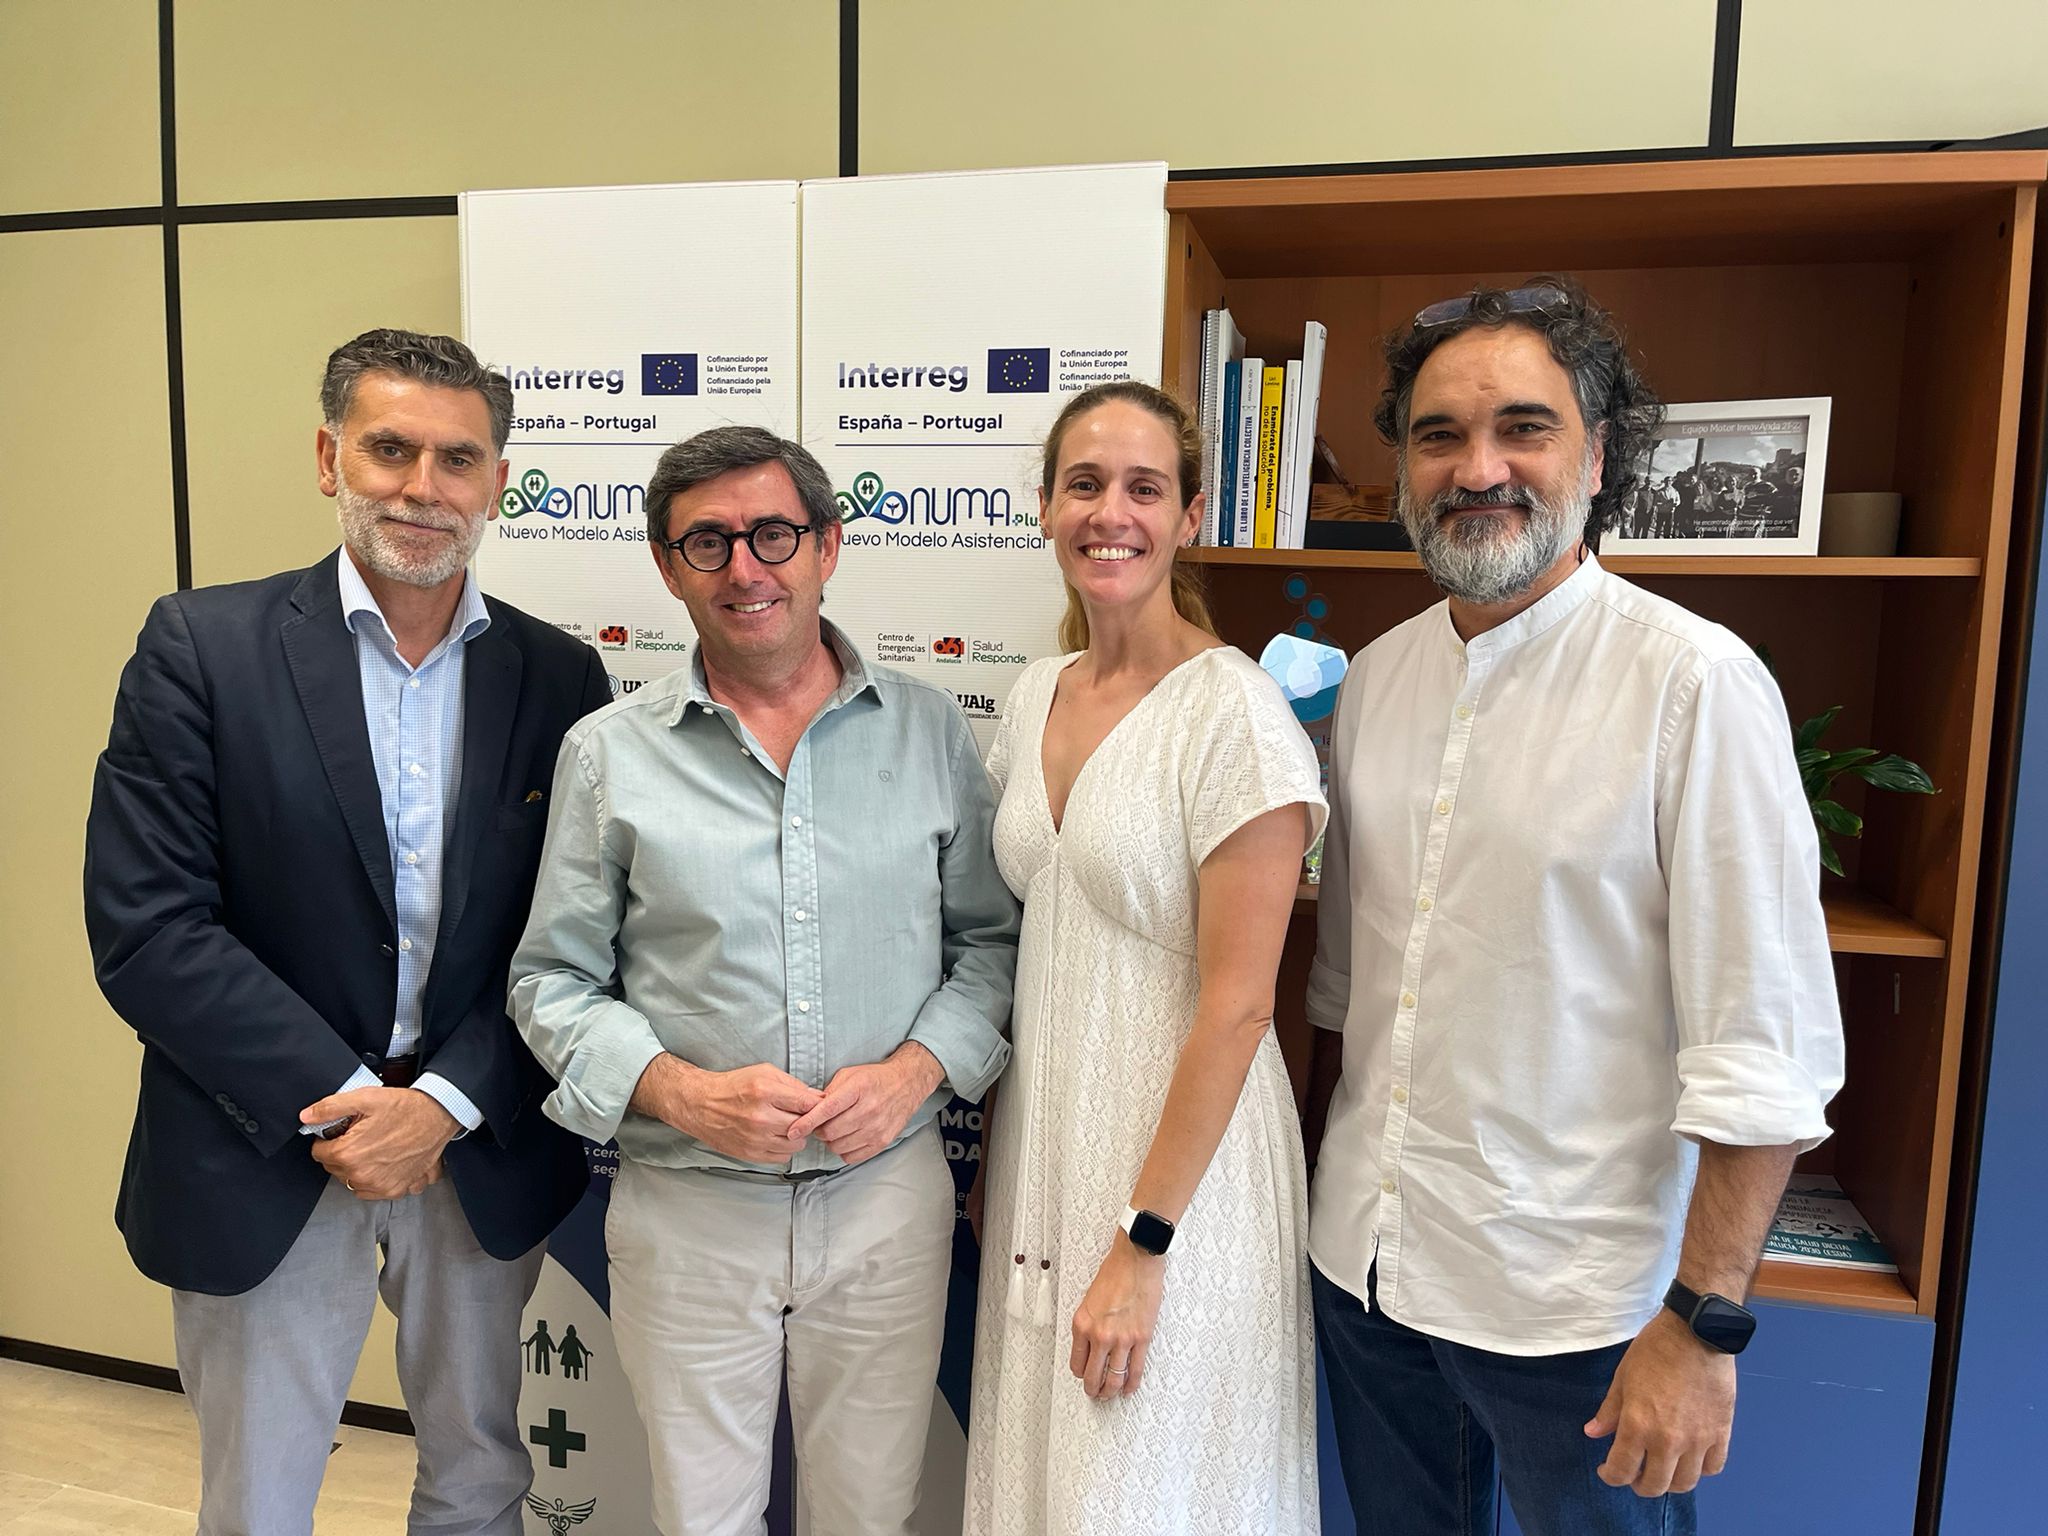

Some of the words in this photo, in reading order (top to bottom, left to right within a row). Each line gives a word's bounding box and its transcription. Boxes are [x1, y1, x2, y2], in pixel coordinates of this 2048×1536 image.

[1060, 349, 1113, 357] Cofinanciado
[1114, 350, 1128, 358] por
[706, 355, 754, 363] Cofinanciado
[755, 356, 768, 364] por
[1060, 360, 1067, 368] la
[1069, 360, 1092, 368] Unión
[1094, 360, 1128, 368] Europea
[715, 364, 736, 372] Unión
[737, 364, 768, 373] Europea
[505, 365, 624, 395] Interreg
[755, 377, 771, 385] pela
[839, 362, 968, 393] Interreg
[1059, 372, 1112, 381] Cofinanciado
[1113, 372, 1131, 381] pela
[729, 386, 761, 395] Europeia
[1263, 405, 1270, 416] no
[584, 415, 656, 433] Portugal
[839, 414, 903, 433] España
[923, 413, 1003, 433] Portugal
[1262, 418, 1269, 428] de
[1269, 405, 1279, 451] Enamórate
[1243, 415, 1253, 448] COLECTIVA
[1262, 430, 1269, 438] la
[1681, 424, 1709, 435] Equipo
[1709, 423, 1736, 433] Motor
[1260, 440, 1269, 474] solución
[1268, 452, 1276, 466] del
[1242, 449, 1251, 489] INTELIGENCIA
[1241, 490, 1249, 498] LA
[1264, 467, 1275, 511] problema,
[574, 484, 648, 520] NUM
[1012, 512, 1041, 527] Plu
[1240, 508, 1249, 525] LIBRO
[499, 524, 548, 540] Nuevo
[552, 525, 609, 541] Modelo
[612, 526, 648, 542] Asis
[1239, 525, 1248, 533] EL
[841, 533, 881, 547] uevo
[885, 531, 947, 548] Modelo
[951, 532, 1046, 549] Asistencial
[572, 623, 582, 631] de
[635, 629, 664, 640] Salud
[877, 632, 904, 642] Centro
[904, 634, 915, 642] de
[635, 640, 686, 652] Responde
[877, 643, 926, 654] Emergencias
[972, 640, 1003, 651] Salud
[877, 652, 916, 662] Sanitarias
[972, 652, 1027, 665] Responde
